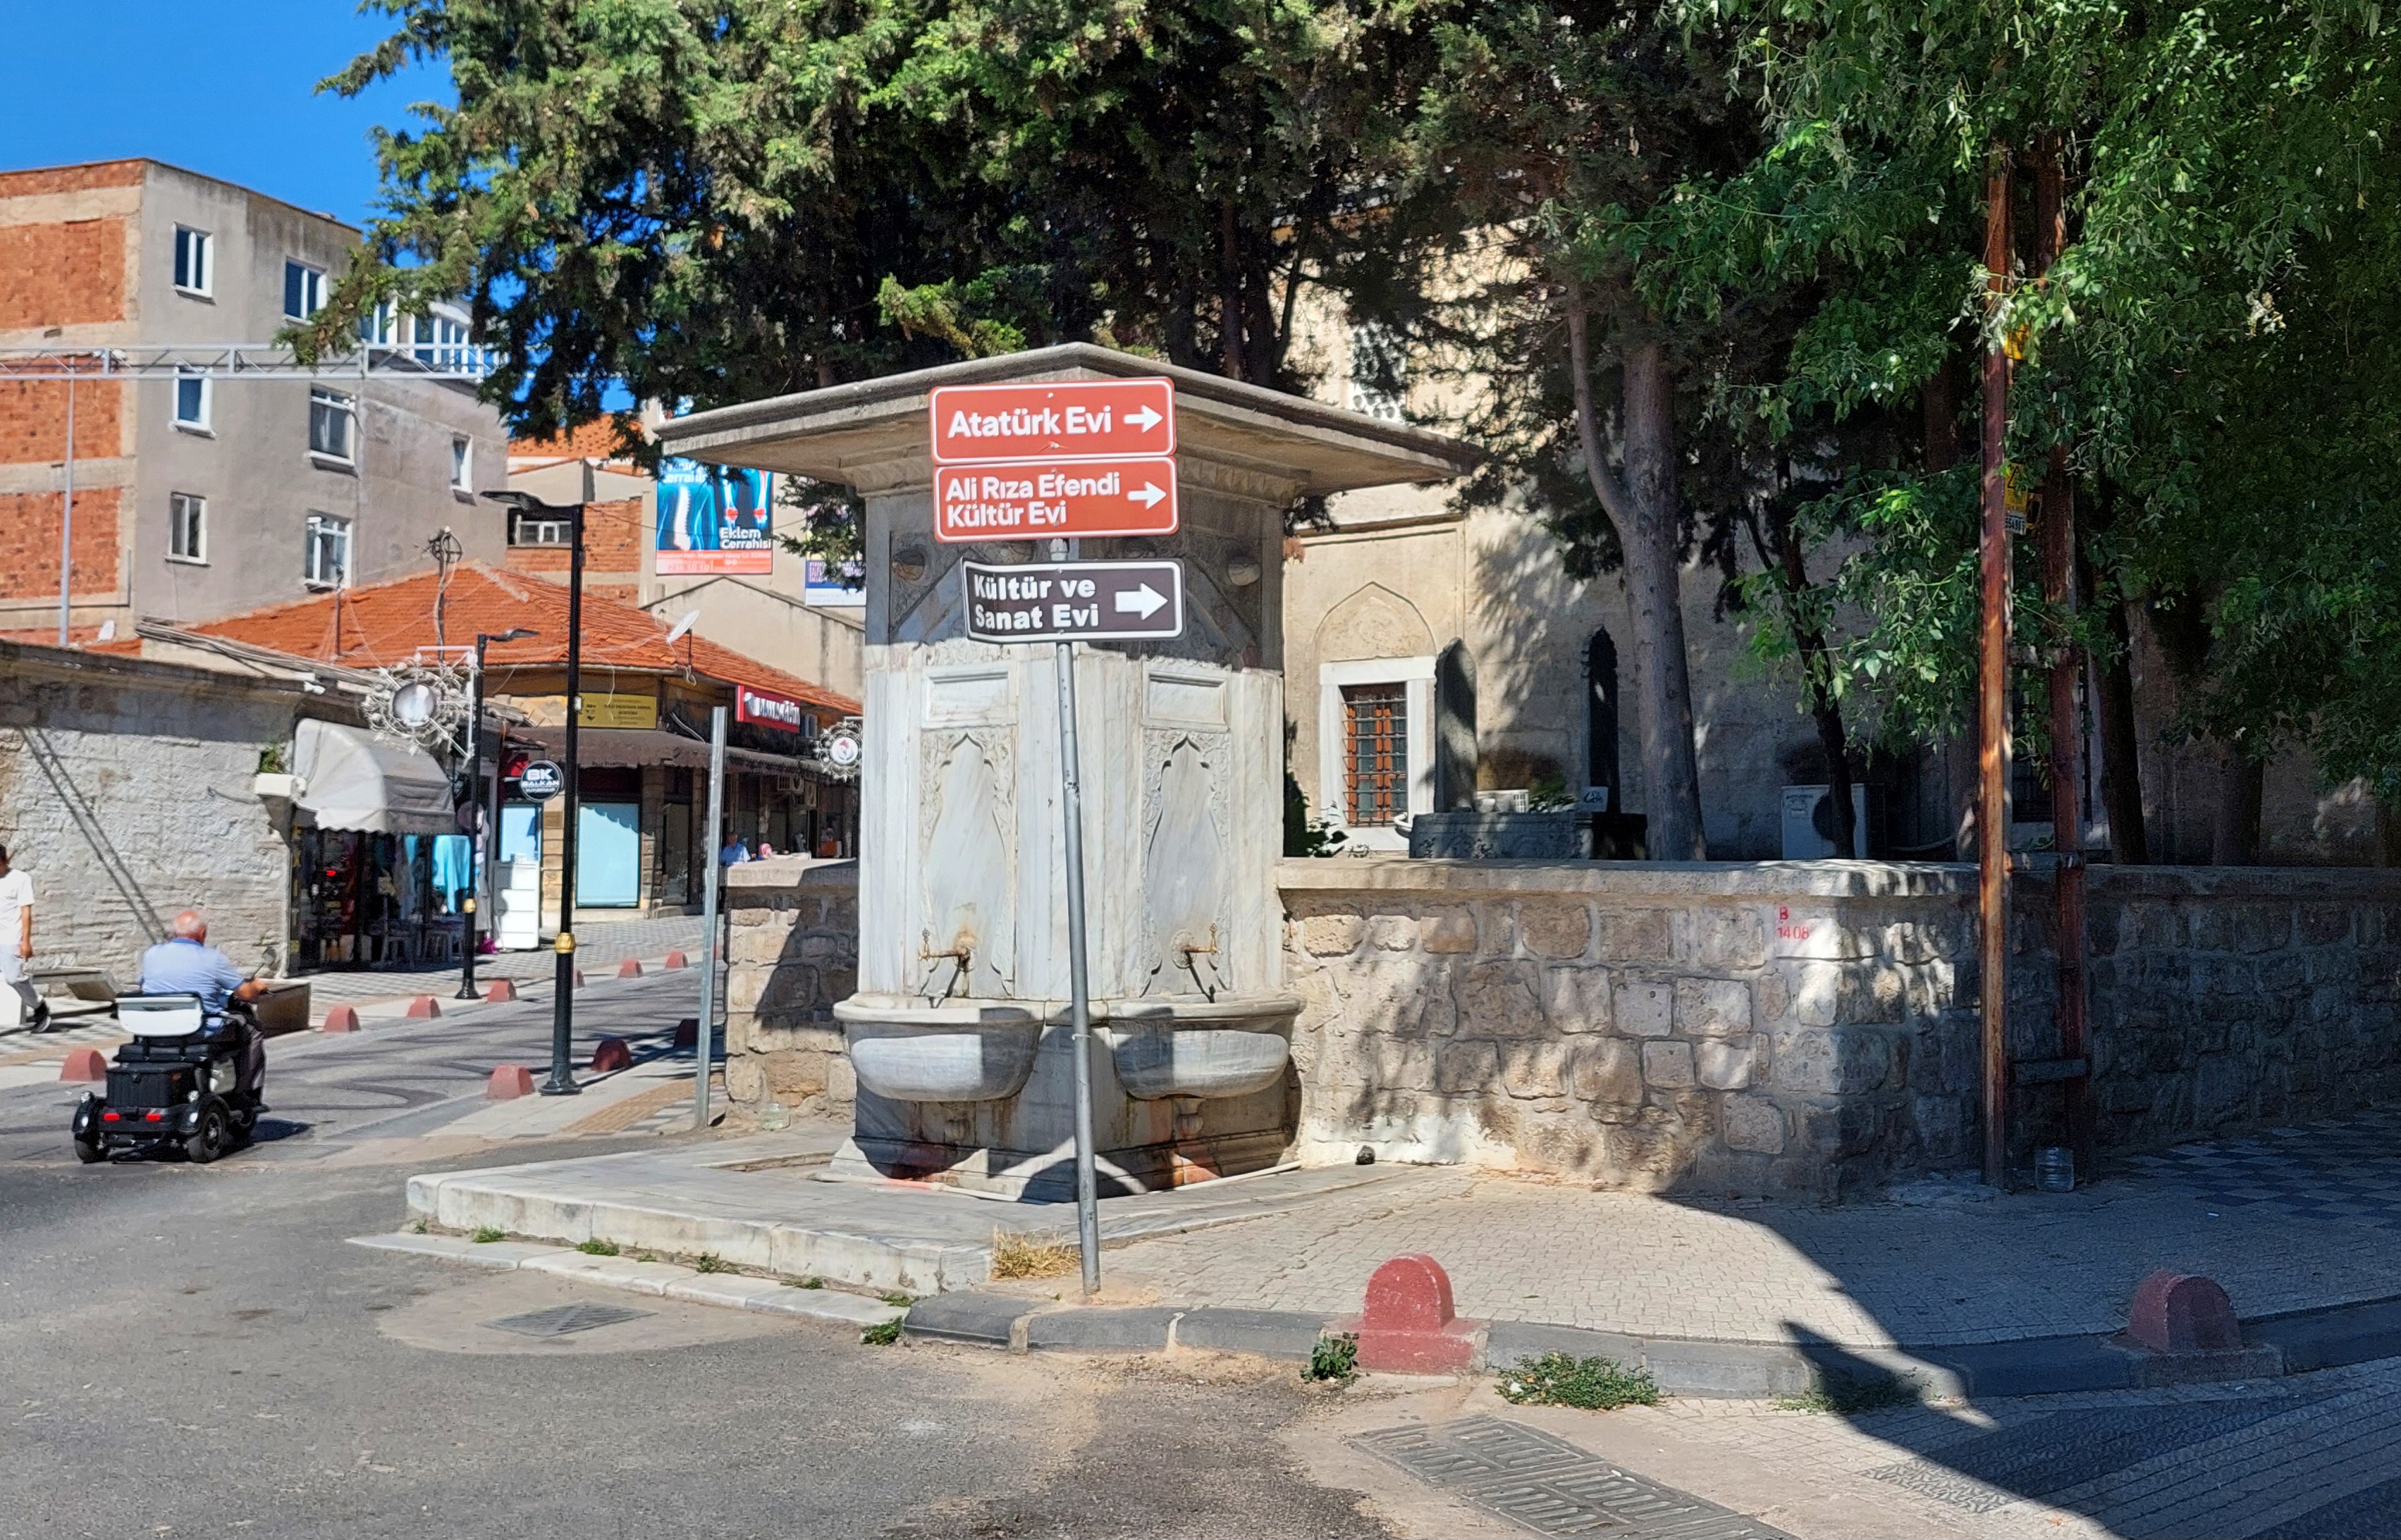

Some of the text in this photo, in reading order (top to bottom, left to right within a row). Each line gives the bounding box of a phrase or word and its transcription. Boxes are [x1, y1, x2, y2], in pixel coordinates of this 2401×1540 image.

[947, 405, 1112, 438] Atatürk Evi
[945, 472, 1121, 502] Ali Rıza Efendi
[947, 500, 1067, 529] Kültür Evi
[719, 526, 761, 539] Eklem
[720, 538, 772, 550] Cerrahisi
[974, 574, 1096, 601] Kültür ve
[975, 603, 1099, 631] Sanat Evi
[527, 768, 553, 780] BK
[1779, 906, 1789, 920] B
[1777, 925, 1810, 940] 1408
